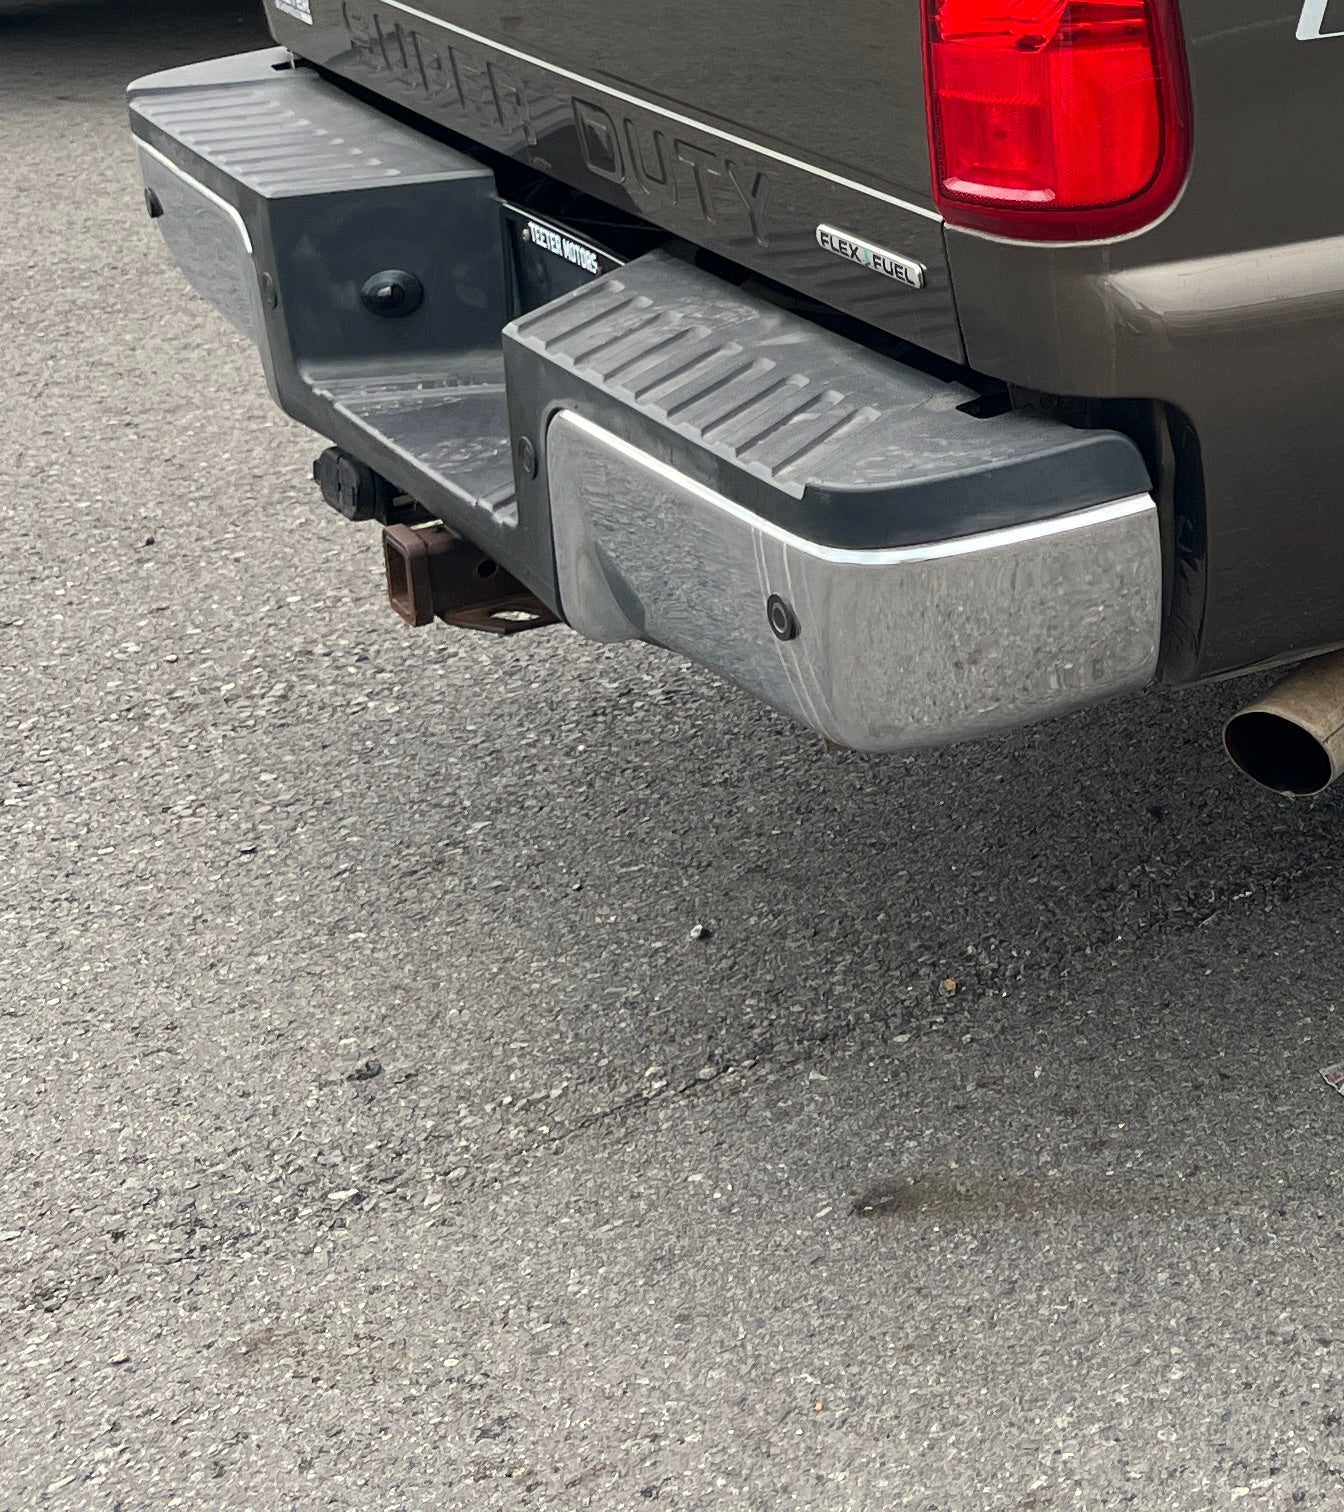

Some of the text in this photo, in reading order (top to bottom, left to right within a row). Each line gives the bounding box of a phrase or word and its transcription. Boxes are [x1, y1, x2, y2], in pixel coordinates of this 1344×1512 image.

[570, 95, 770, 248] DUTY
[527, 221, 599, 275] TEETER MOTORS
[820, 231, 915, 286] FLEX FUEL
